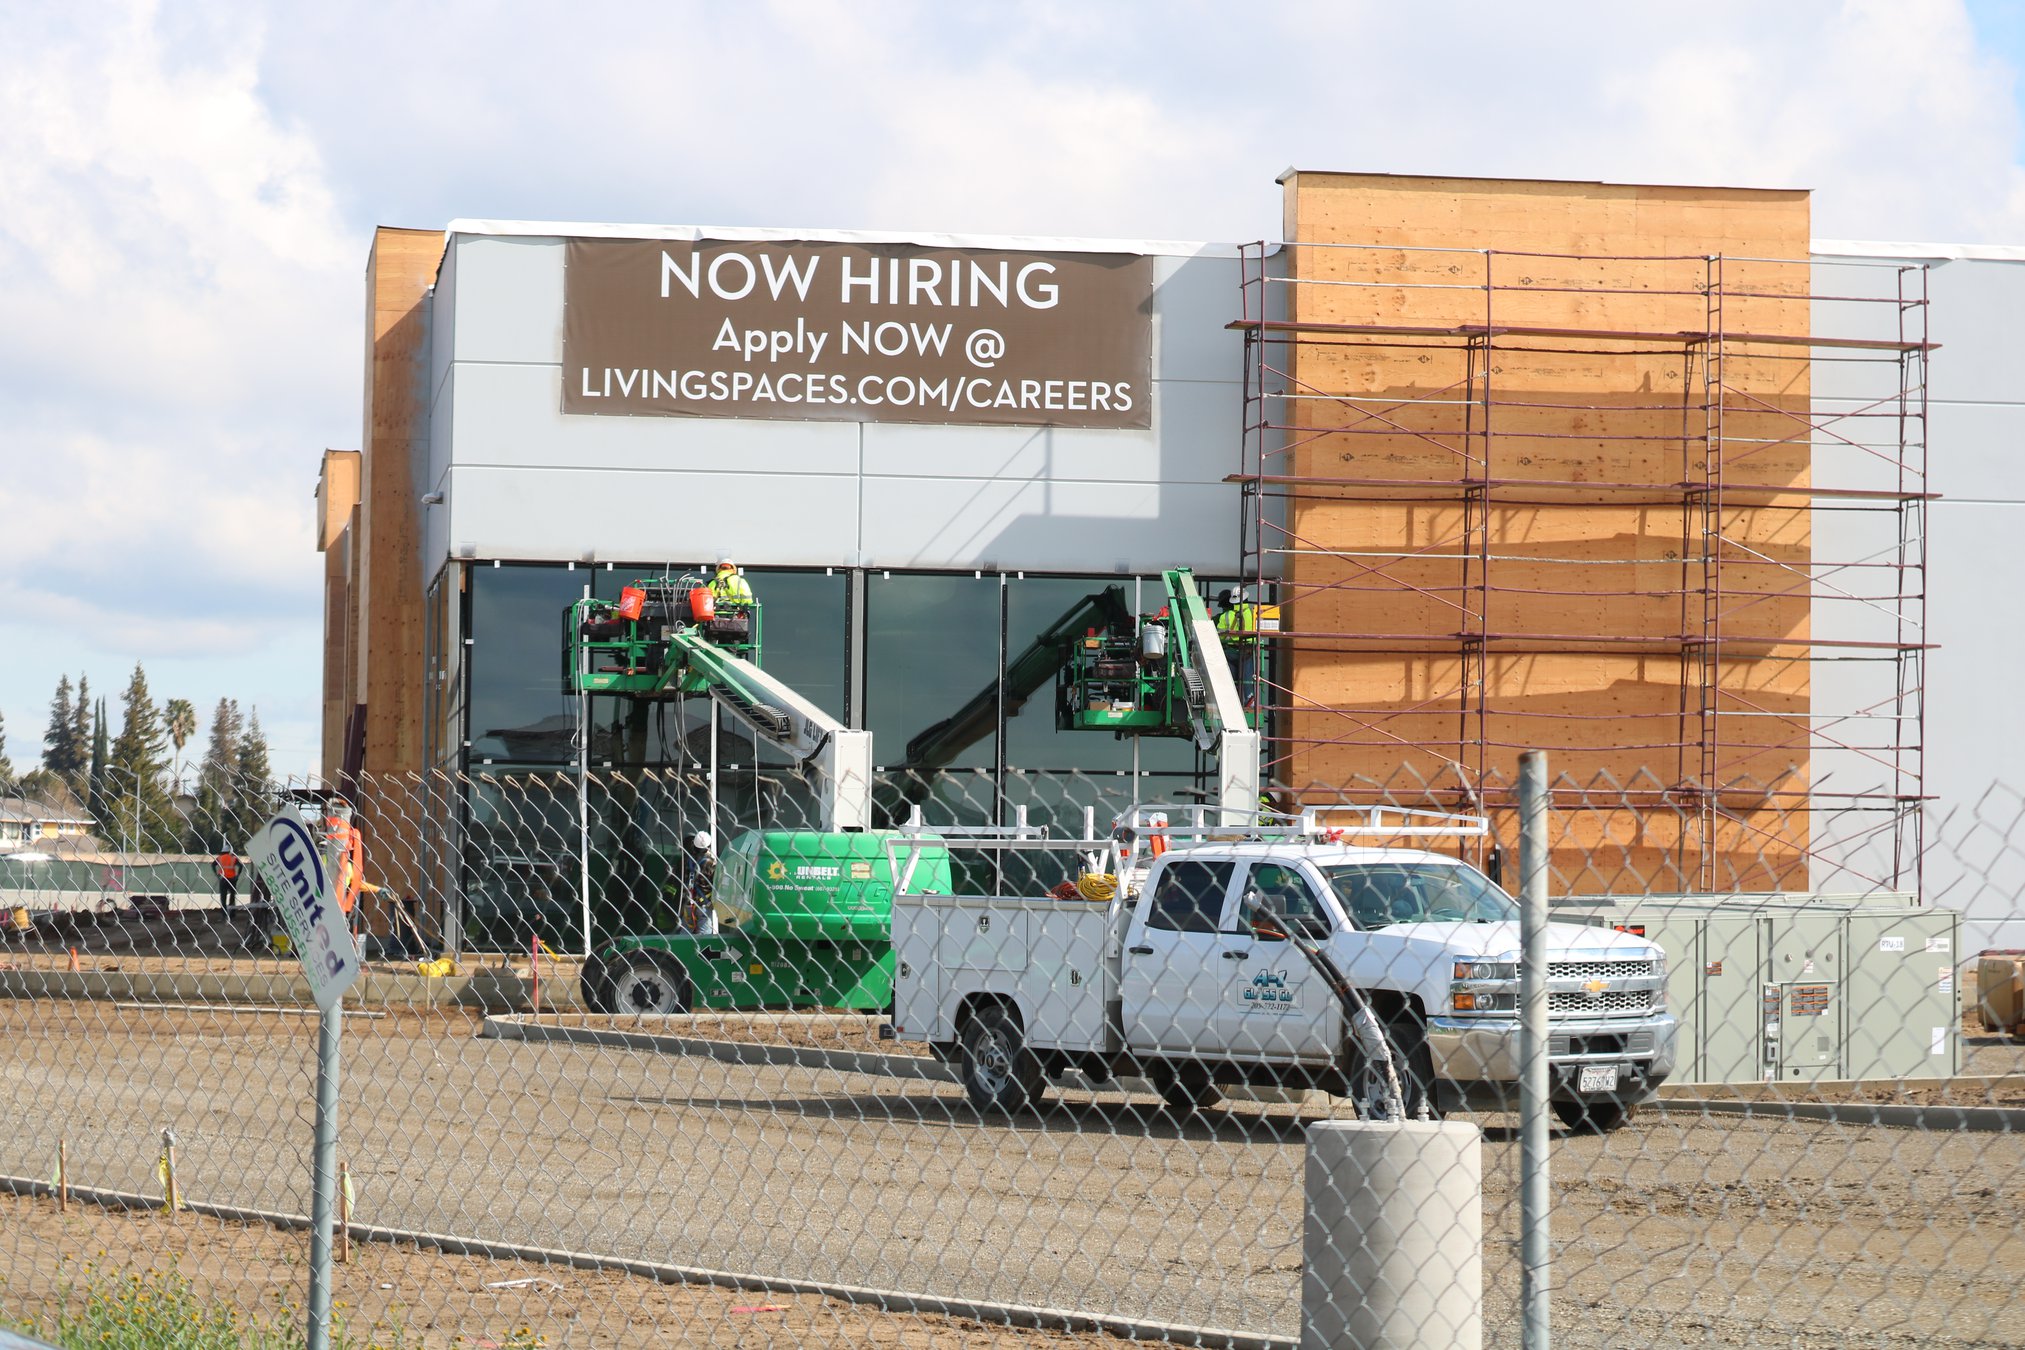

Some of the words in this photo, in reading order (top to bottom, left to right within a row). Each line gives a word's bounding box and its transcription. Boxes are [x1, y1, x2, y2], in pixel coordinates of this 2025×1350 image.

[661, 251, 819, 302] NOW
[842, 257, 1058, 309] HIRING
[713, 318, 828, 363] Apply
[842, 321, 952, 357] NOW
[966, 329, 1004, 367] @
[582, 367, 1133, 412] LIVINGSPACES.COM/CAREERS
[794, 866, 839, 876] UNBELT
[257, 861, 321, 994] 1-833-USS-FECE
[266, 853, 291, 893] SITE
[289, 898, 328, 988] SERVCES
[278, 833, 346, 978] United
[1244, 988, 1276, 1001] GLSS
[1253, 969, 1288, 987] A-1
